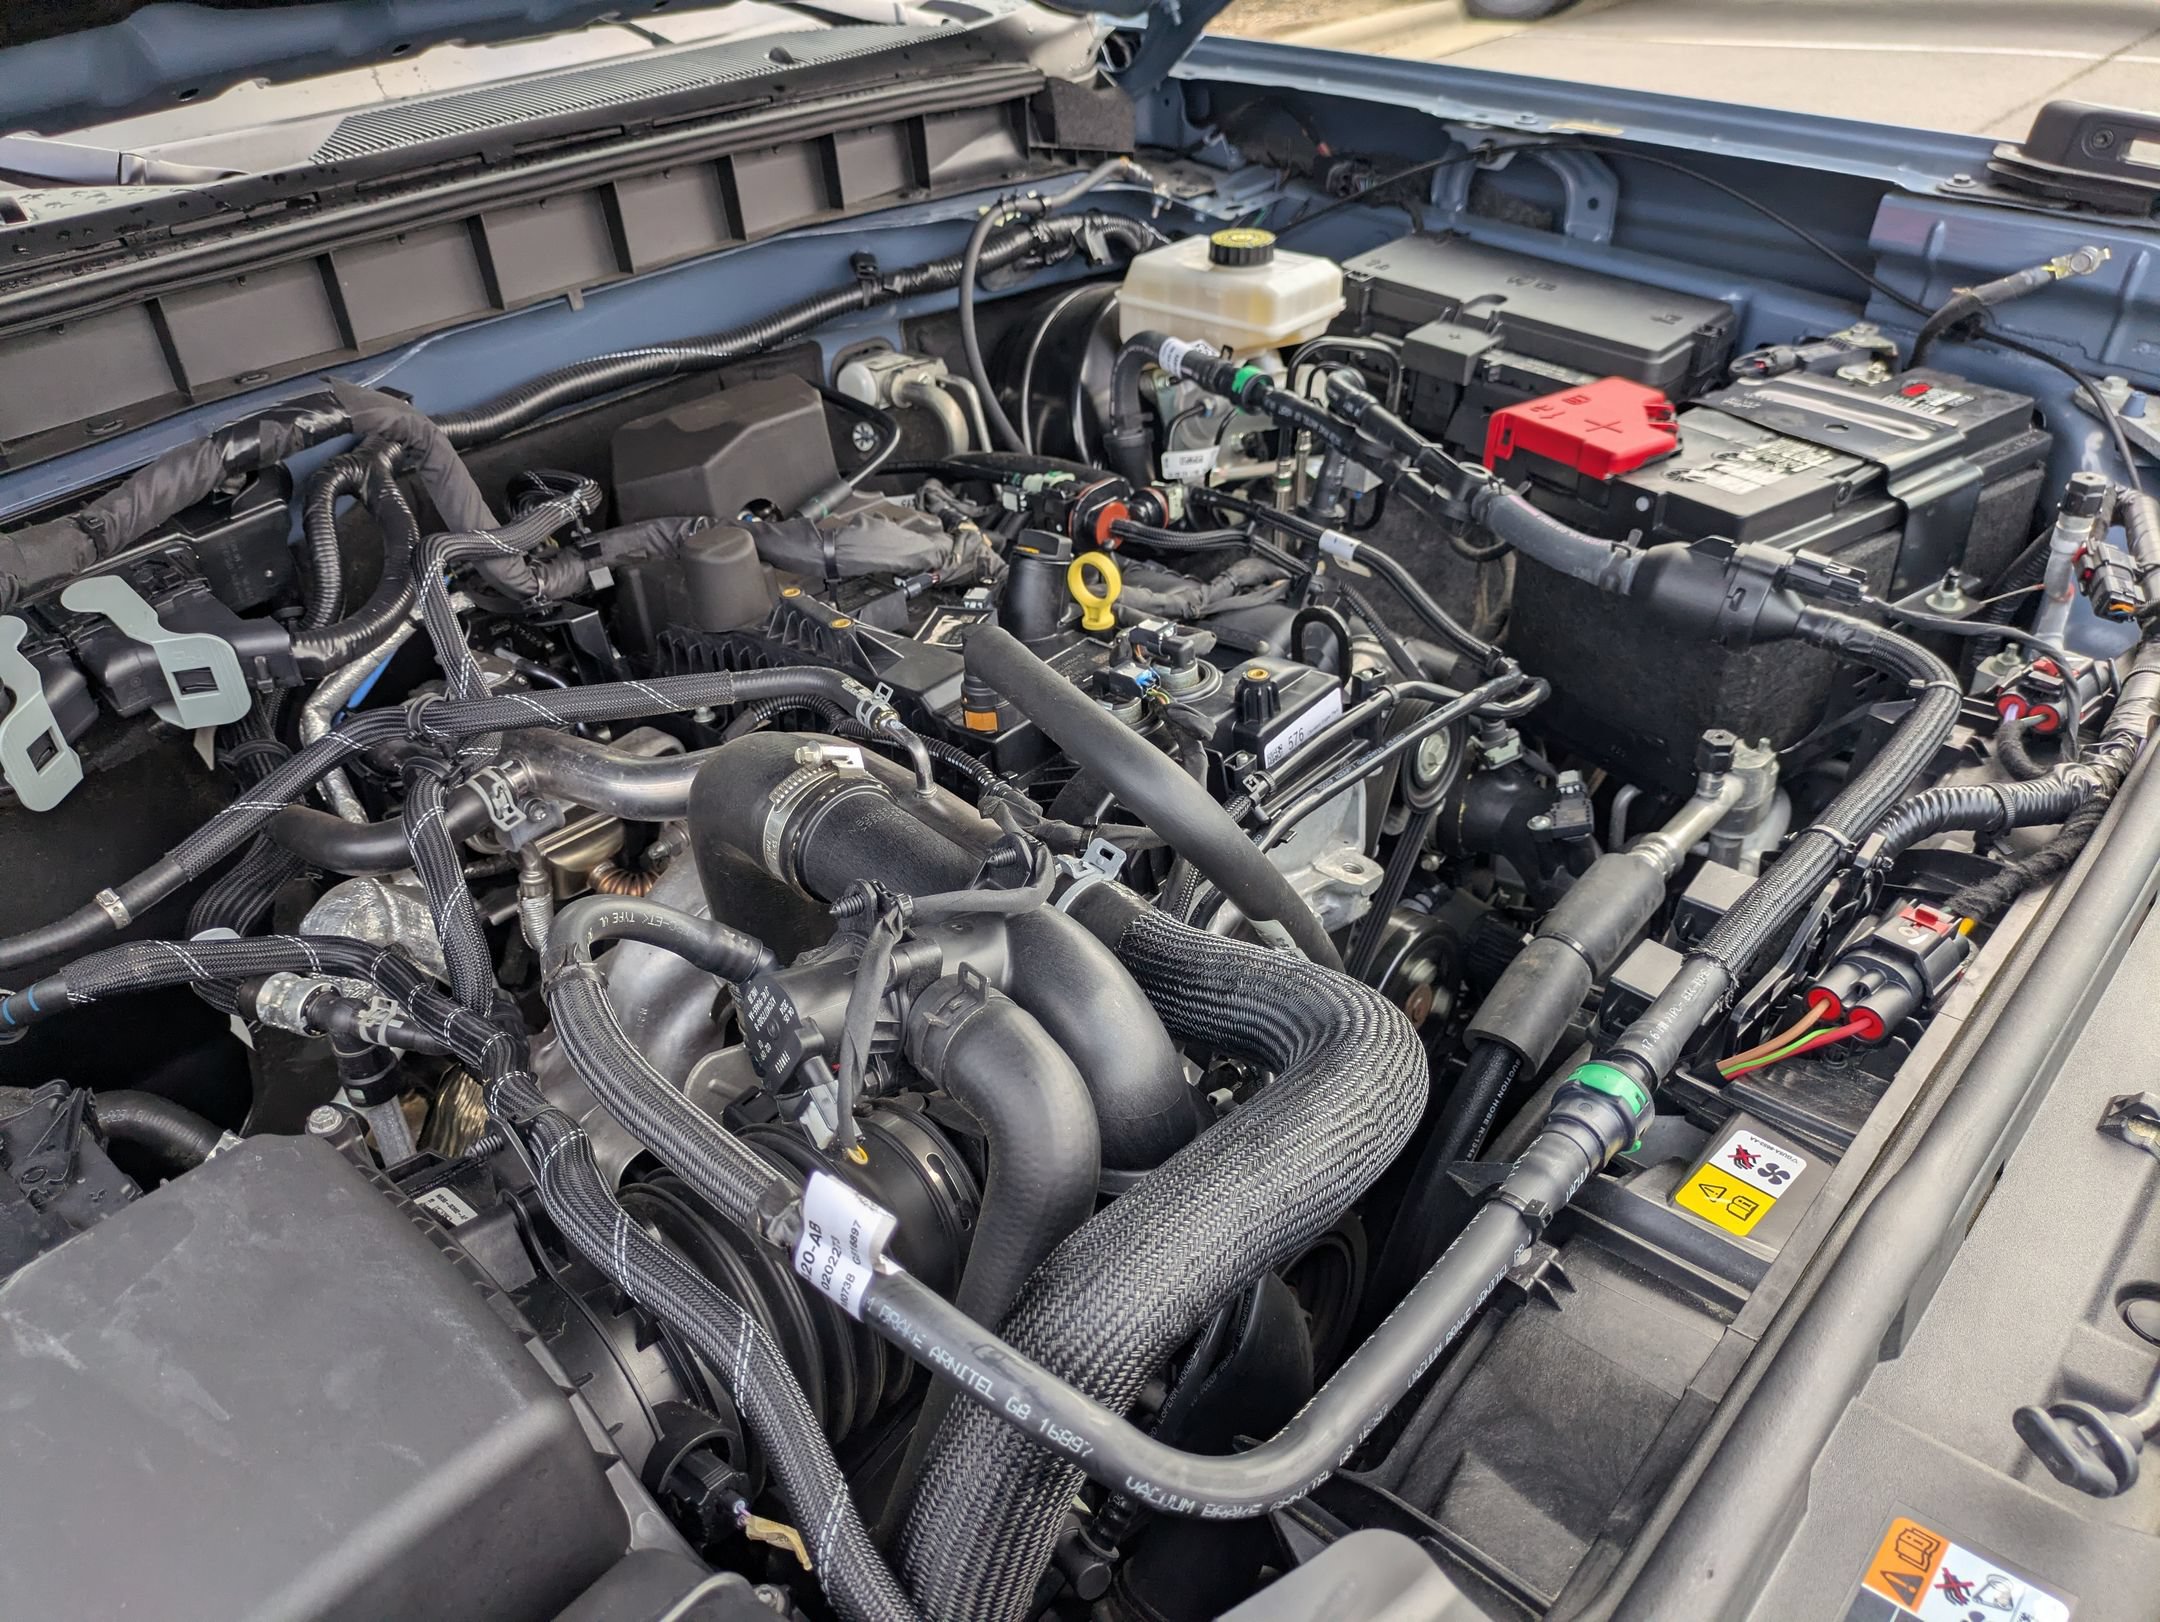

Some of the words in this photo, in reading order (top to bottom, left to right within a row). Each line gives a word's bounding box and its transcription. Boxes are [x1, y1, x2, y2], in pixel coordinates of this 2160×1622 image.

[877, 1304, 928, 1350] BRAKE
[928, 1345, 997, 1402] ARNITEL
[1004, 1396, 1033, 1421] GB
[1038, 1417, 1095, 1459] 16897
[1125, 1475, 1197, 1515] VACUUM
